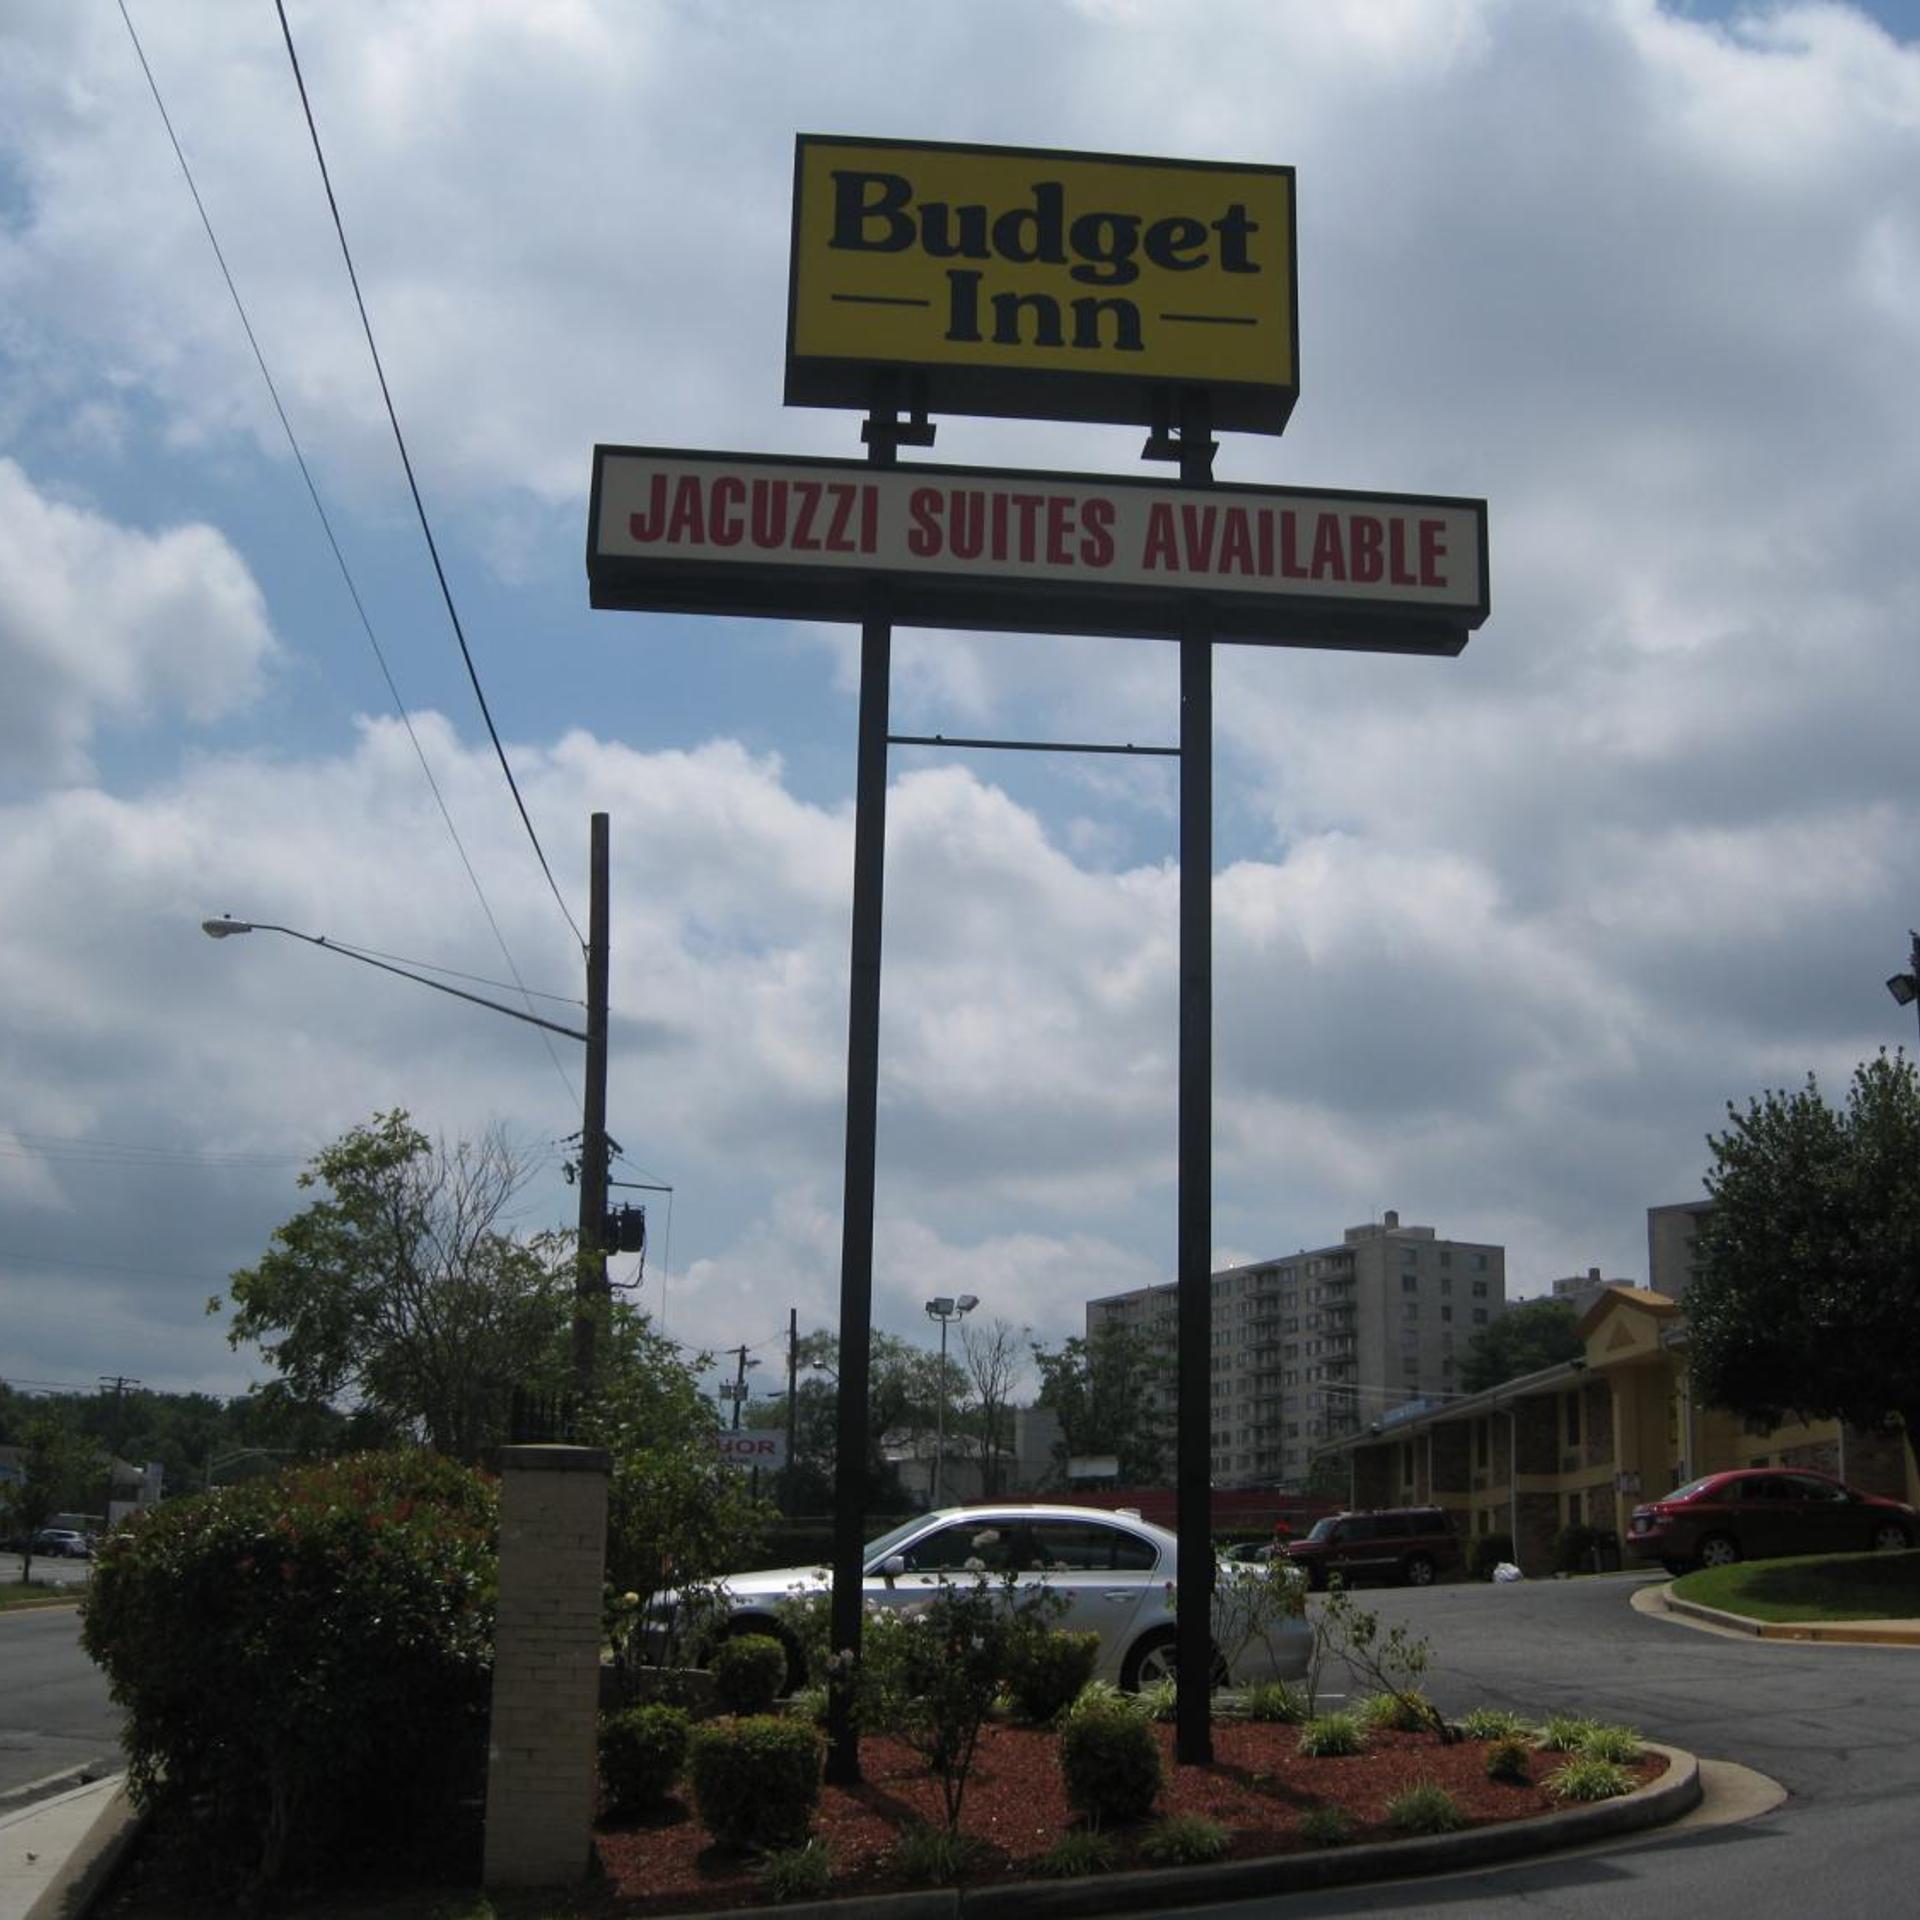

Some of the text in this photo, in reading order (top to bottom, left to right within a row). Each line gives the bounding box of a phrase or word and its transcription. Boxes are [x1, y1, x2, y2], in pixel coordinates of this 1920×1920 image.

[828, 169, 1262, 286] Budget
[944, 269, 1146, 352] Inn
[630, 474, 1448, 587] JACUZZI SUITES AVAILABLE
